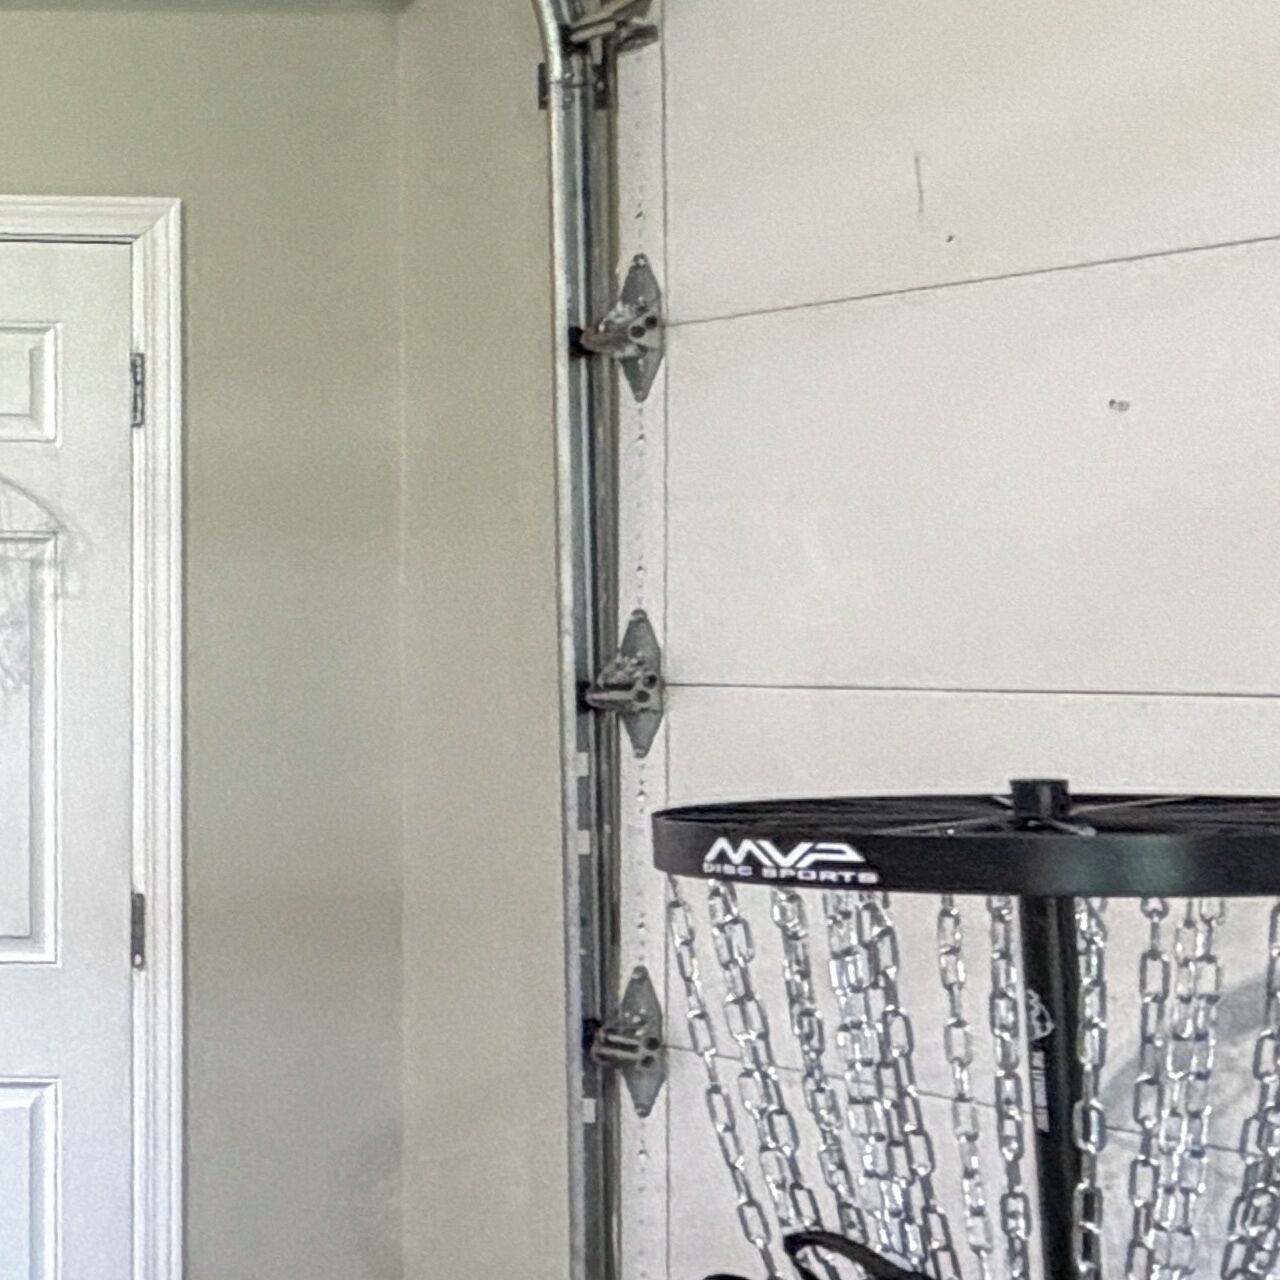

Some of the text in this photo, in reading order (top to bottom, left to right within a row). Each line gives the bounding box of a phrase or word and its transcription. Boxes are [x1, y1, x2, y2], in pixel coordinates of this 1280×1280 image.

[704, 837, 866, 868] MVP
[702, 862, 879, 884] DISC SPORTS
